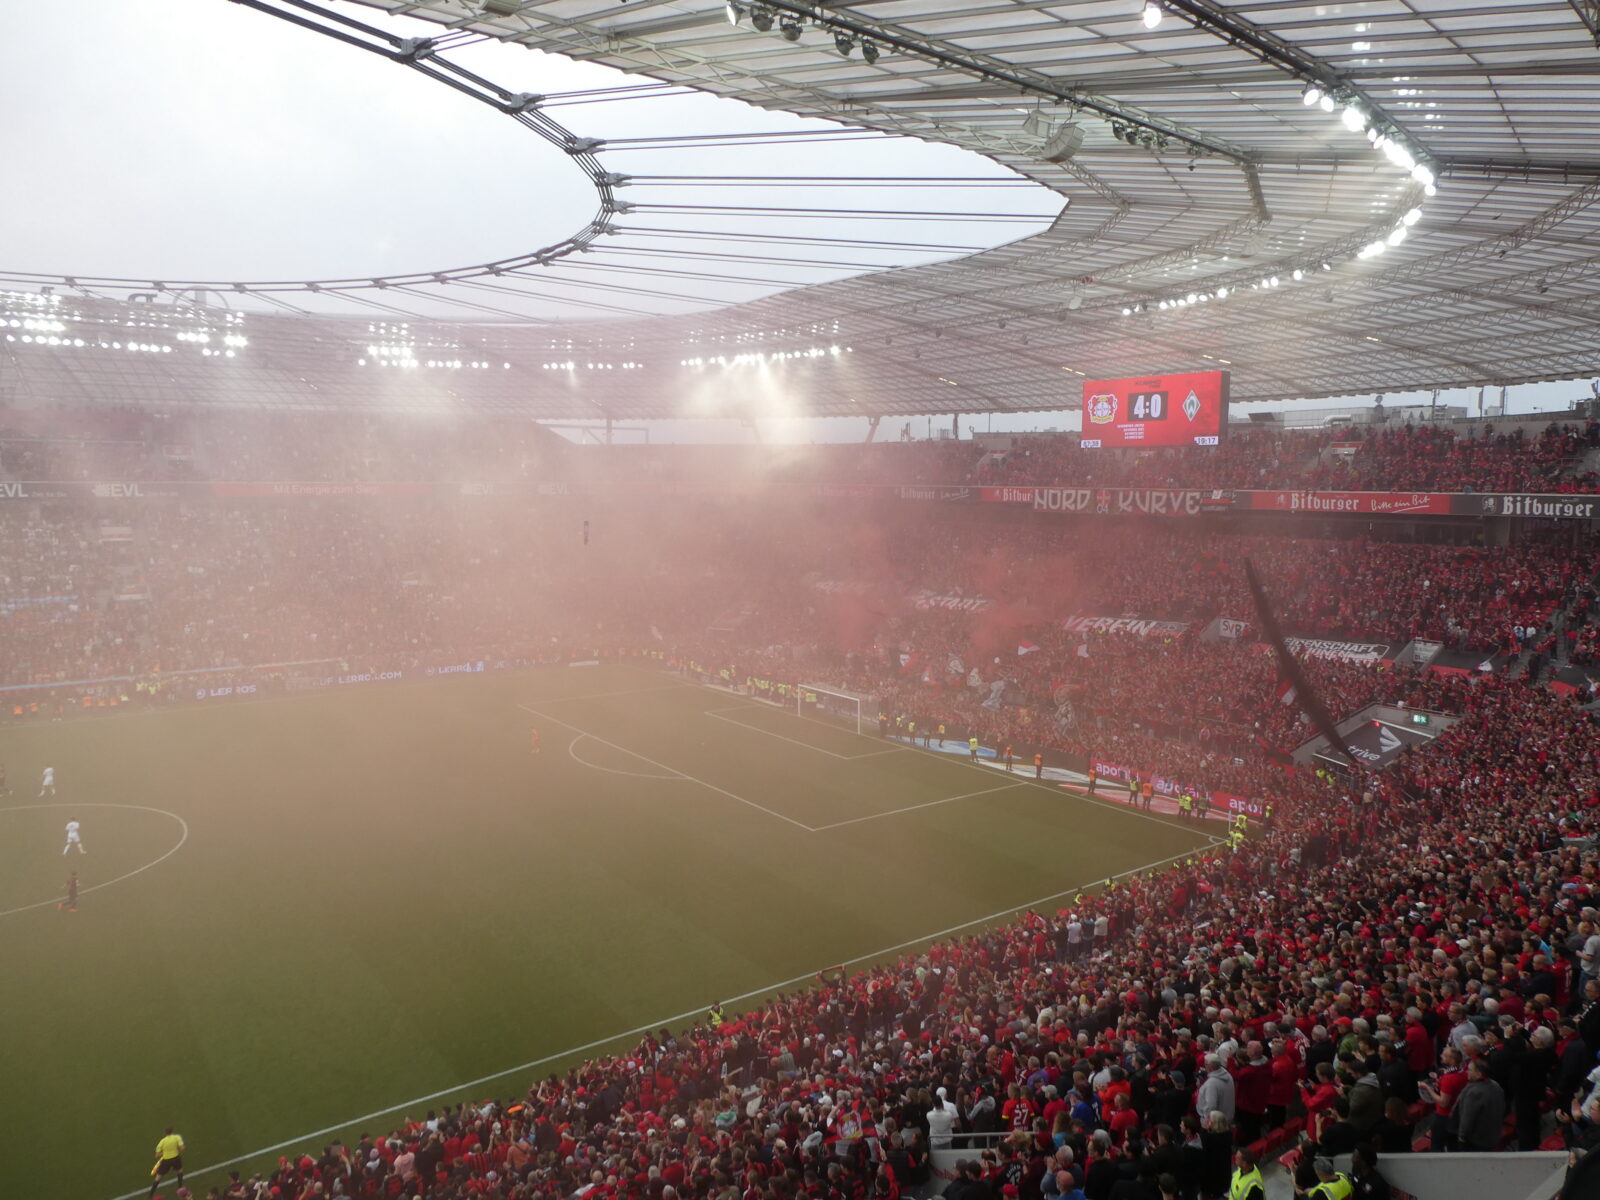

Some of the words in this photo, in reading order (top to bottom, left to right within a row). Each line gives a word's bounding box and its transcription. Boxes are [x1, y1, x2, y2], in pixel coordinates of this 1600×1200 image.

[1133, 393, 1162, 419] 4:0
[111, 483, 144, 497] EVL
[1034, 489, 1091, 511] NORD
[1118, 490, 1200, 515] KURVE
[1290, 492, 1359, 511] Bitburger
[1501, 494, 1595, 516] Bitburger
[1062, 615, 1157, 635] VEREIN
[1013, 1108, 1029, 1126] 27
